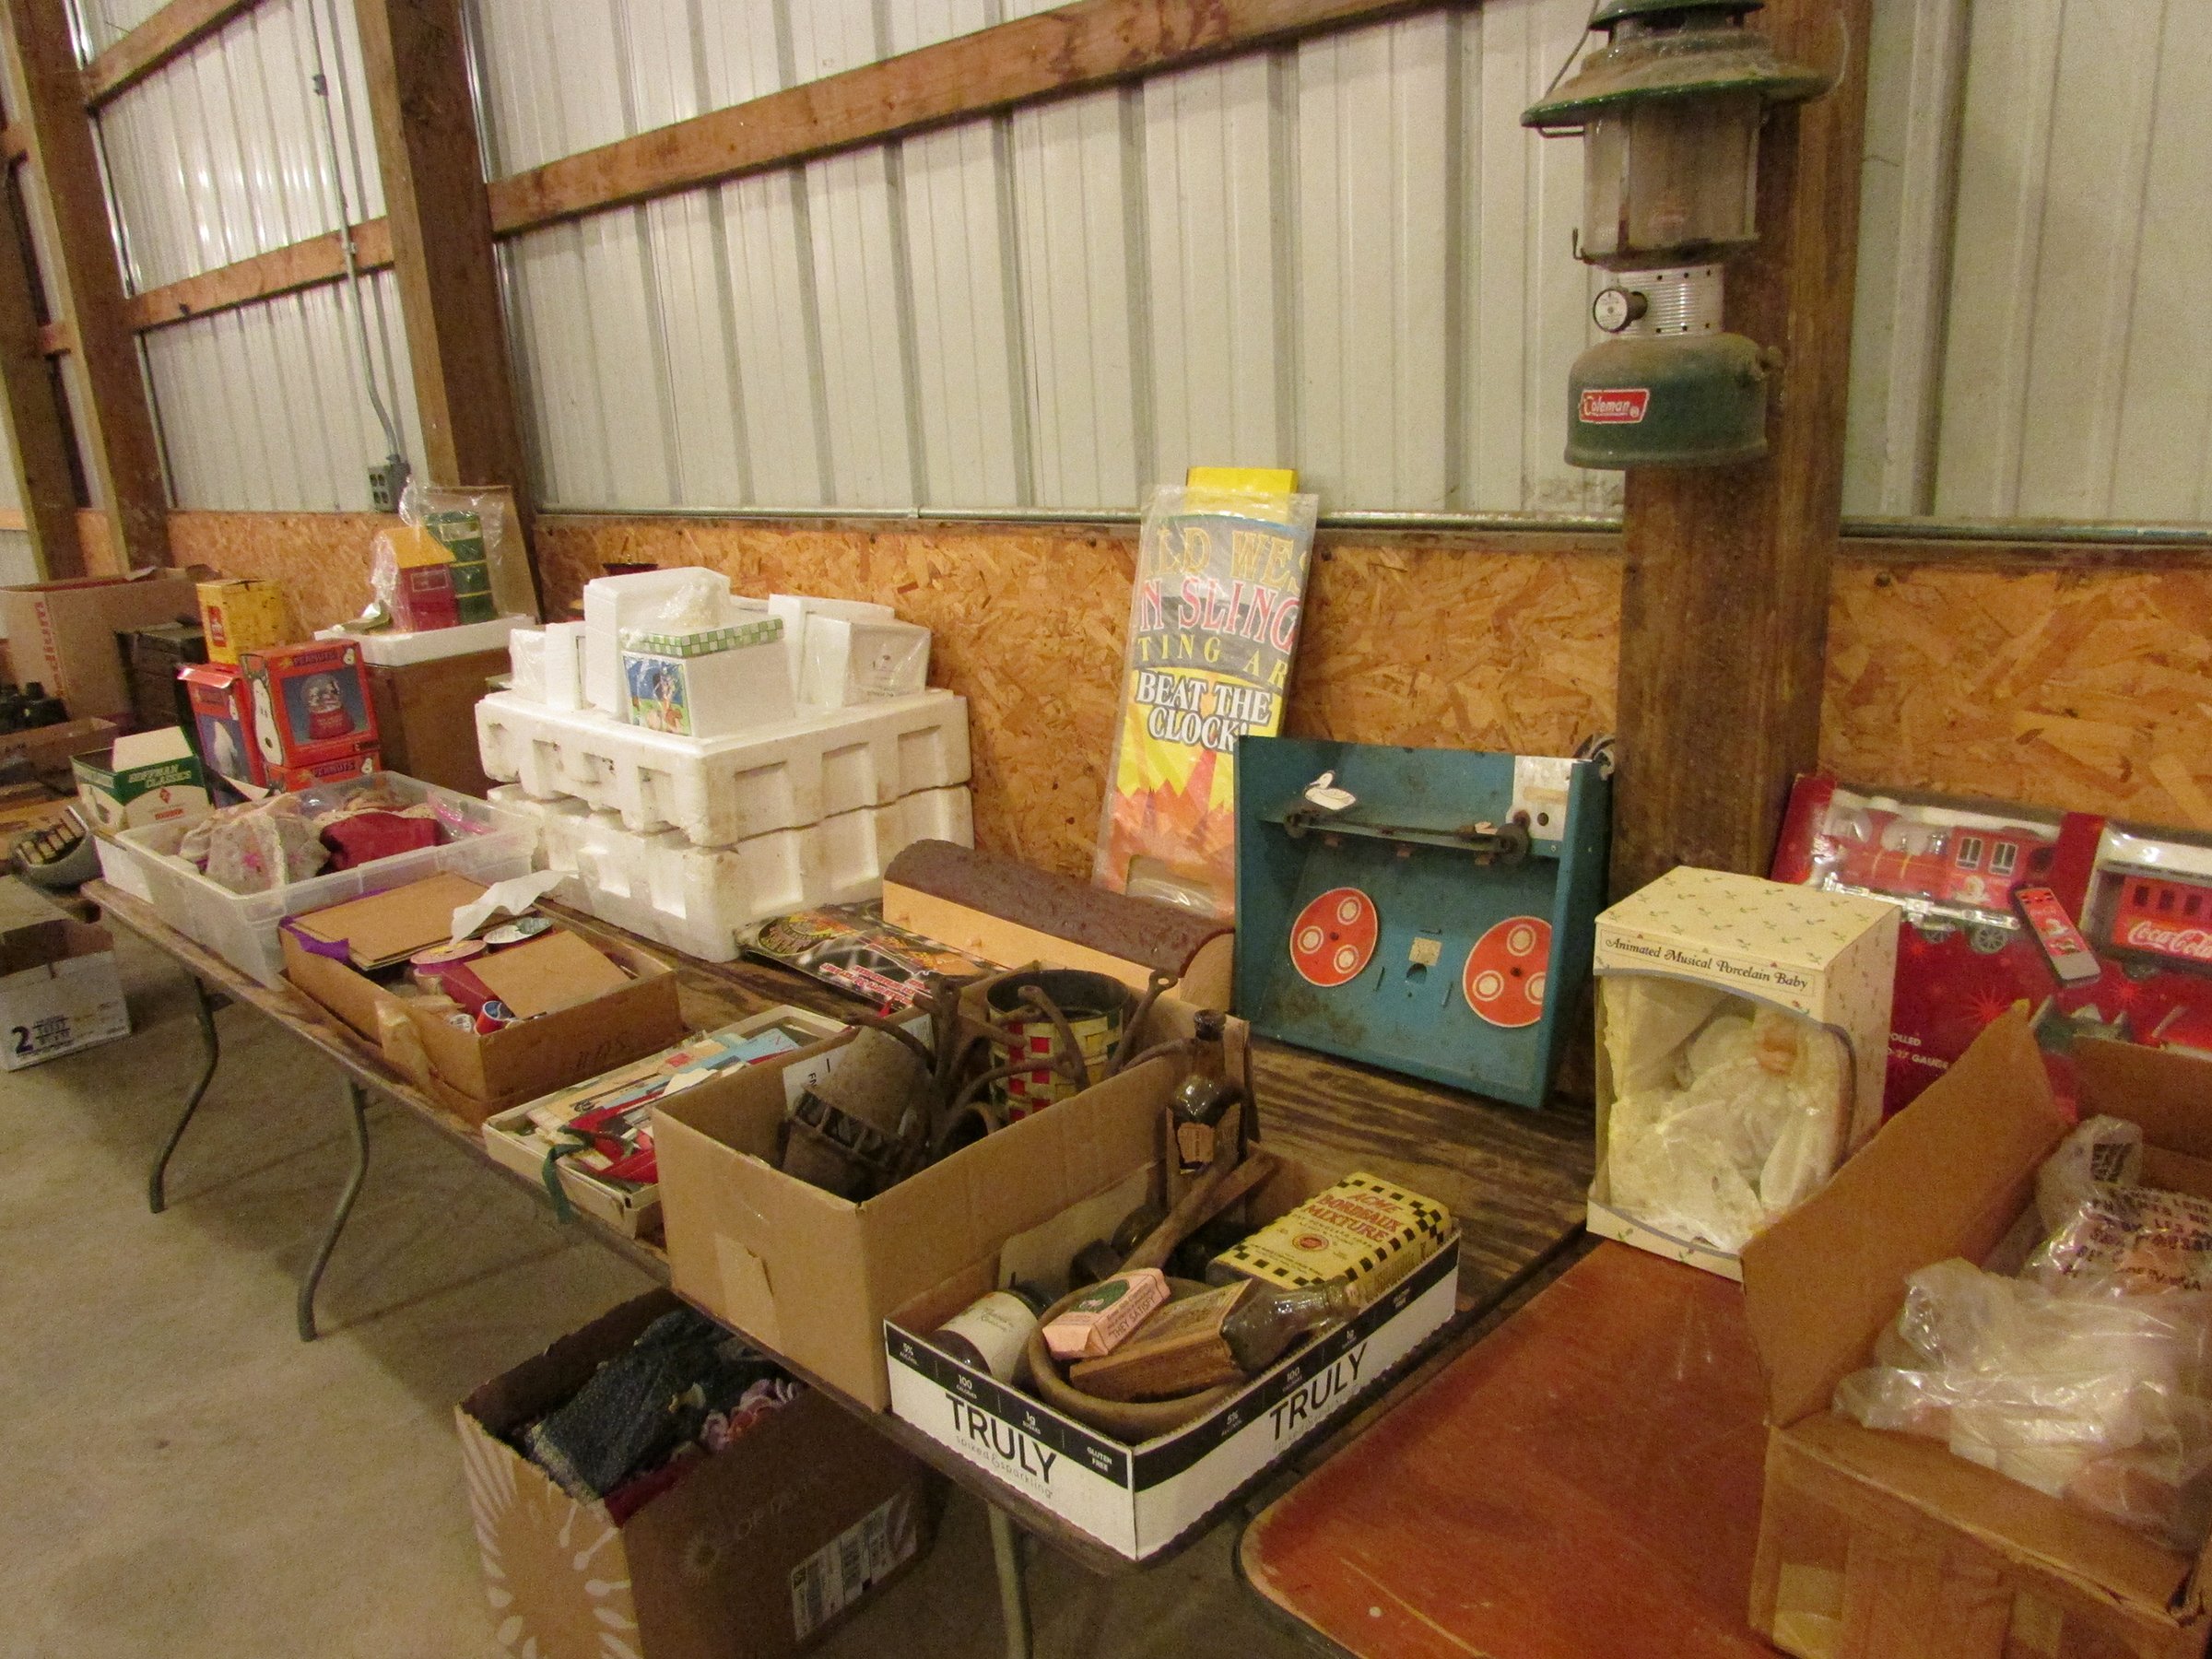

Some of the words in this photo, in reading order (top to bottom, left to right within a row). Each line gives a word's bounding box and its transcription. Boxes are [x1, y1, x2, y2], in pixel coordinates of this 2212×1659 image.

[1584, 395, 1630, 416] Coleman
[1135, 671, 1207, 712] BEAT
[1214, 683, 1272, 724] THE
[1605, 937, 1662, 959] Animated
[1664, 949, 1713, 970] Musical
[1716, 959, 1771, 982] Porcelain
[1773, 971, 1809, 991] Baby
[11, 1025, 34, 1054] 2
[1315, 1193, 1405, 1233] BORDEAUX
[1347, 1192, 1405, 1214] ACME
[1303, 1204, 1391, 1243] MIXTURE
[958, 1373, 973, 1391] 100
[1269, 1341, 1369, 1441] TRULY
[945, 1392, 1058, 1485] TRULY
[1086, 1445, 1113, 1465] GLUTEN
[1091, 1456, 1110, 1473] FREE
